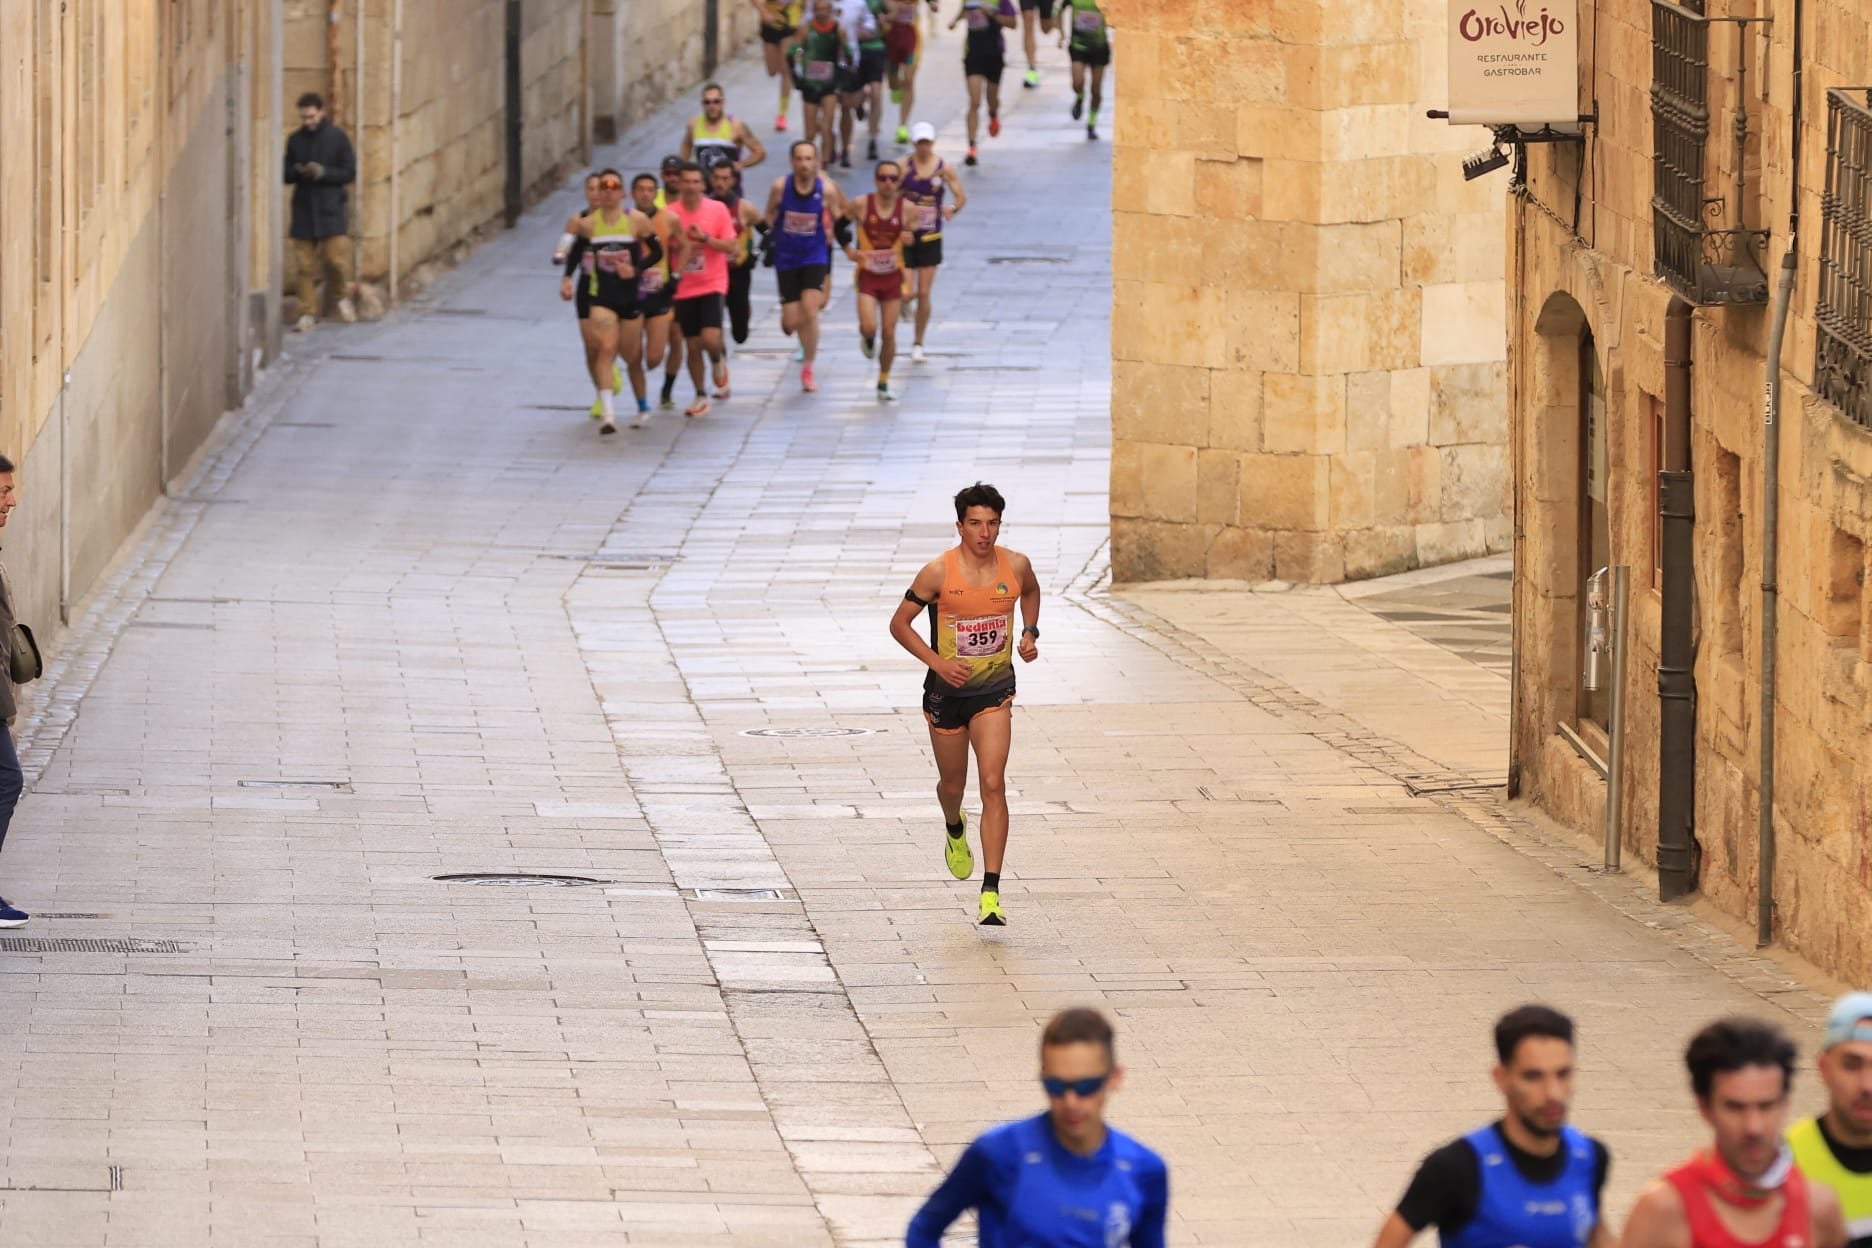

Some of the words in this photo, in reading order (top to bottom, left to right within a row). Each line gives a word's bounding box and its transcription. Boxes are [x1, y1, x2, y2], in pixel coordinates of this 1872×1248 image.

[1477, 53, 1548, 63] RESTAURANTE
[1484, 67, 1542, 77] GASTROBAR
[968, 630, 997, 646] 359
